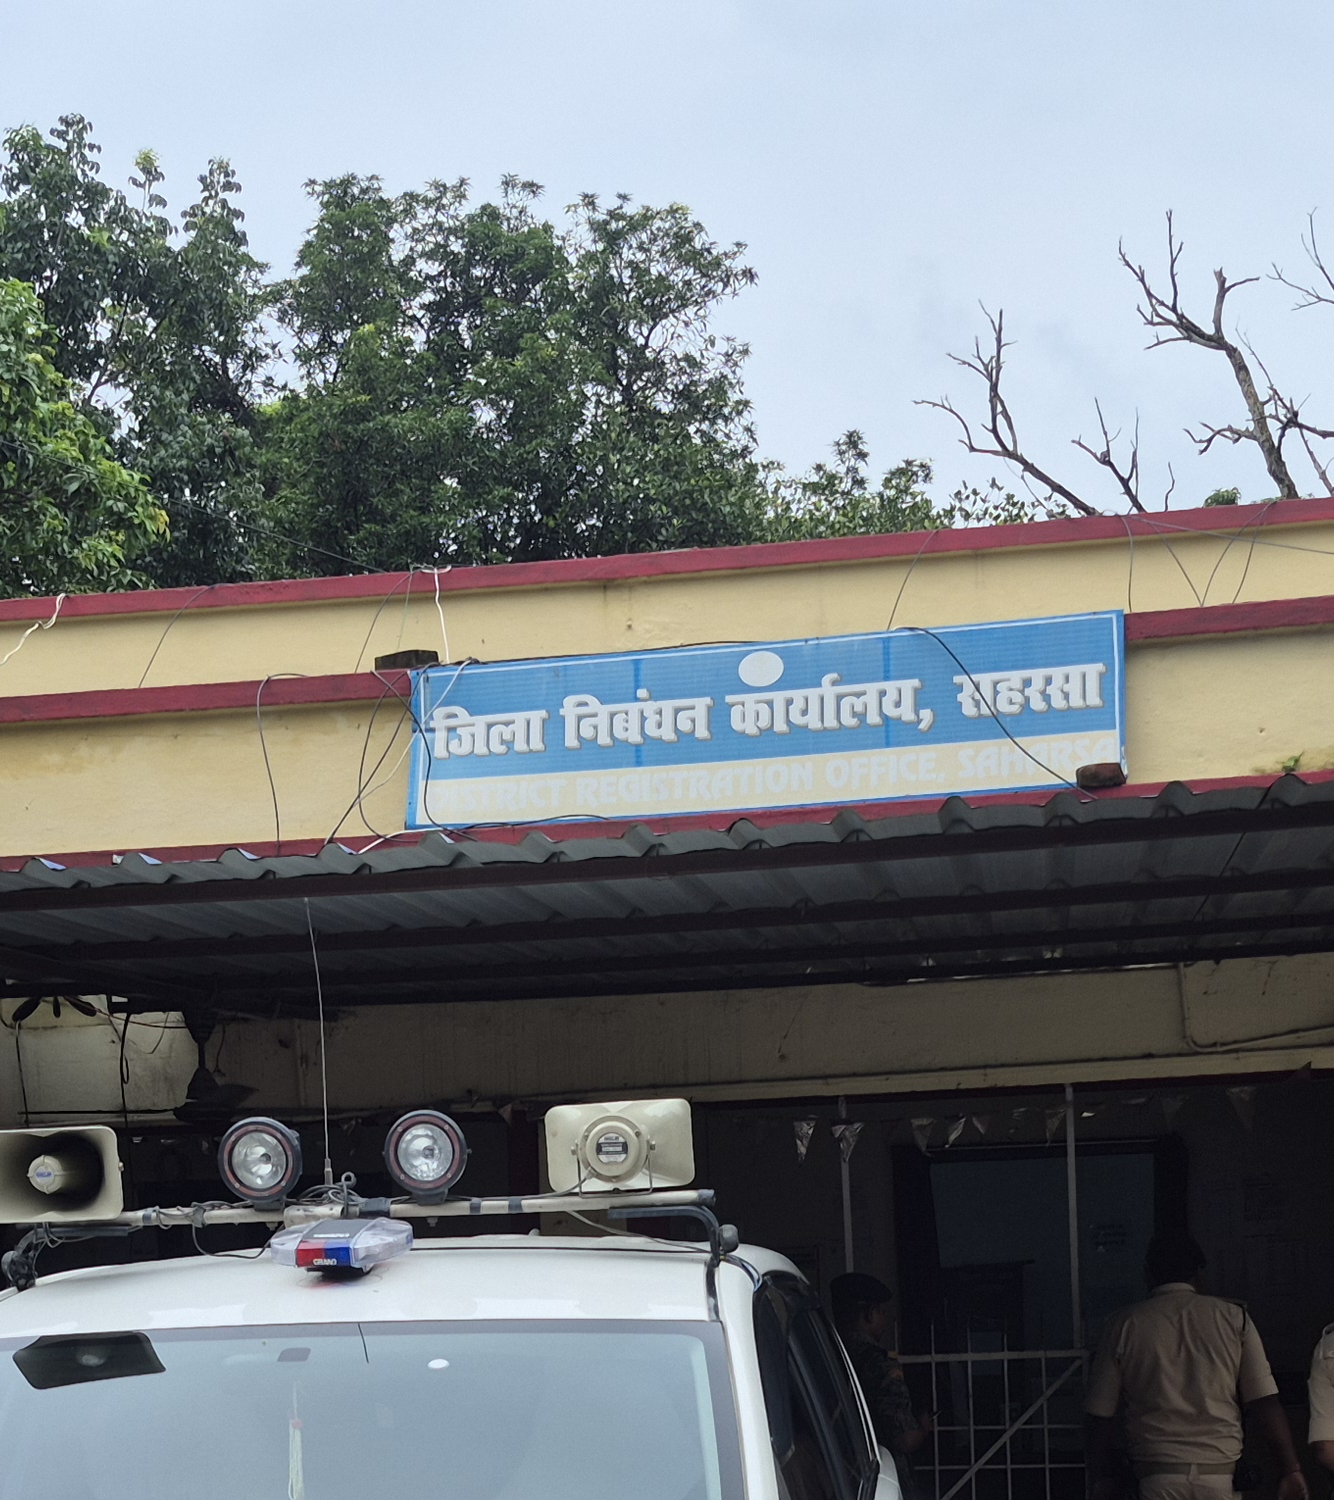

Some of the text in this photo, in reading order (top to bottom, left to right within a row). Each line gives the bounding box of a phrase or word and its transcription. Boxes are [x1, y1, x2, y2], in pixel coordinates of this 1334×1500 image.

[430, 662, 1106, 760] जिला निबंधन कार्यालय, सहरसा
[430, 735, 1117, 811] DISTRICT REGISTRATION OFFICE, SAHARSA
